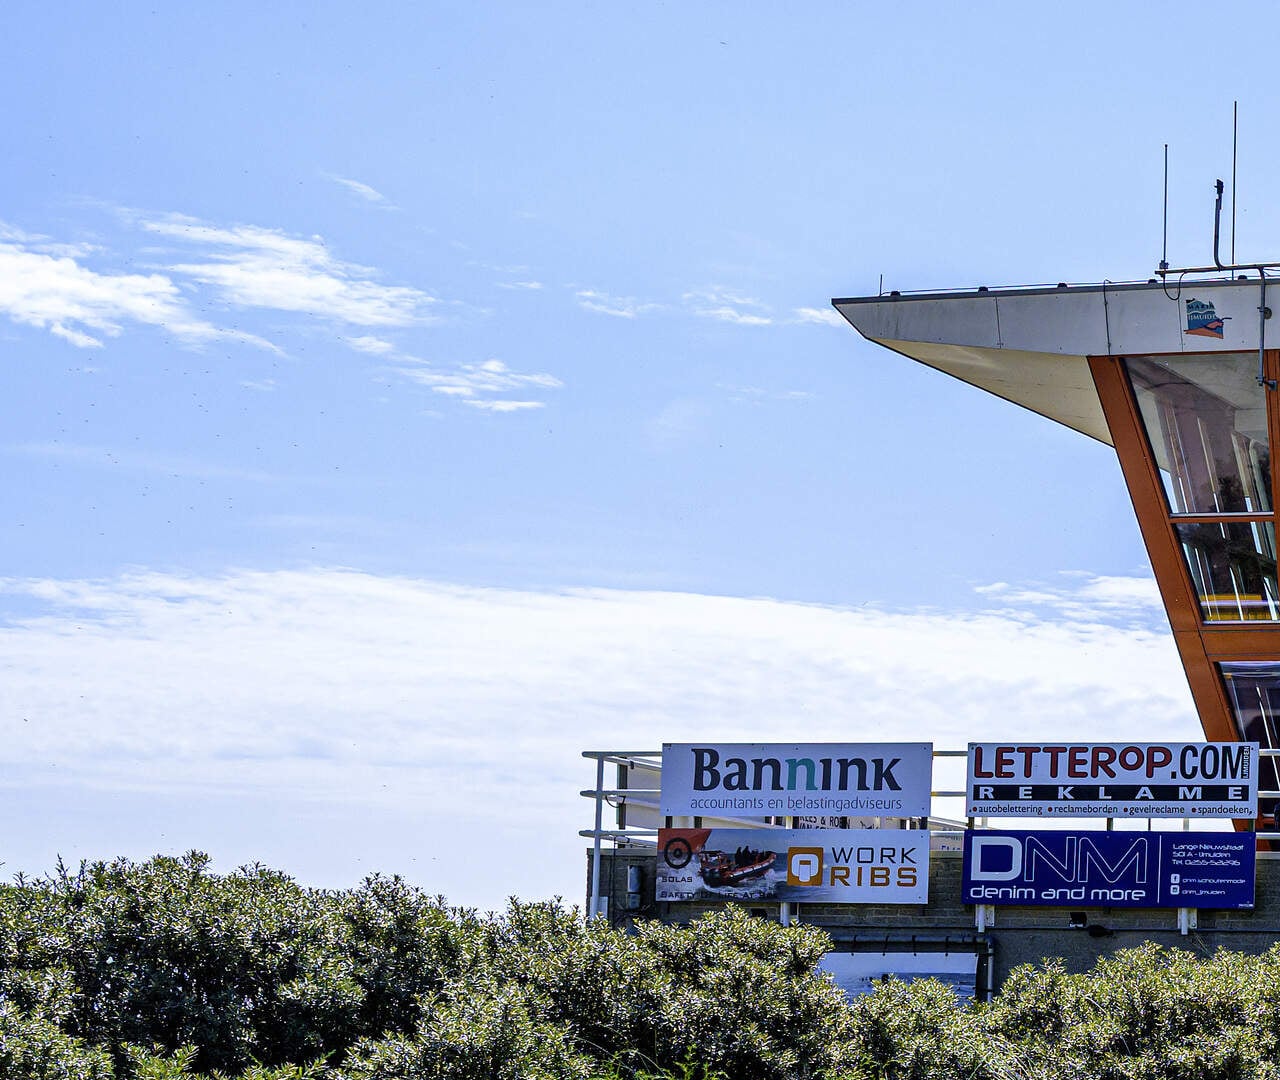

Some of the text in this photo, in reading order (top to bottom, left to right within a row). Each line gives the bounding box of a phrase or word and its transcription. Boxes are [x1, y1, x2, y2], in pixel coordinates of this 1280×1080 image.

[691, 748, 902, 790] Bannink
[973, 745, 1243, 780] LETTEROP.COM
[978, 786, 1243, 800] REKLAME
[690, 796, 903, 812] accountants en belastingadviseurs
[978, 802, 1043, 814] autobelettering
[1054, 802, 1119, 813] reclameborden
[1129, 802, 1185, 815] gevelreclame
[831, 847, 917, 864] WORK
[970, 836, 1148, 883] DNM
[830, 867, 917, 888] RIBS
[970, 885, 1146, 901] denim and more
